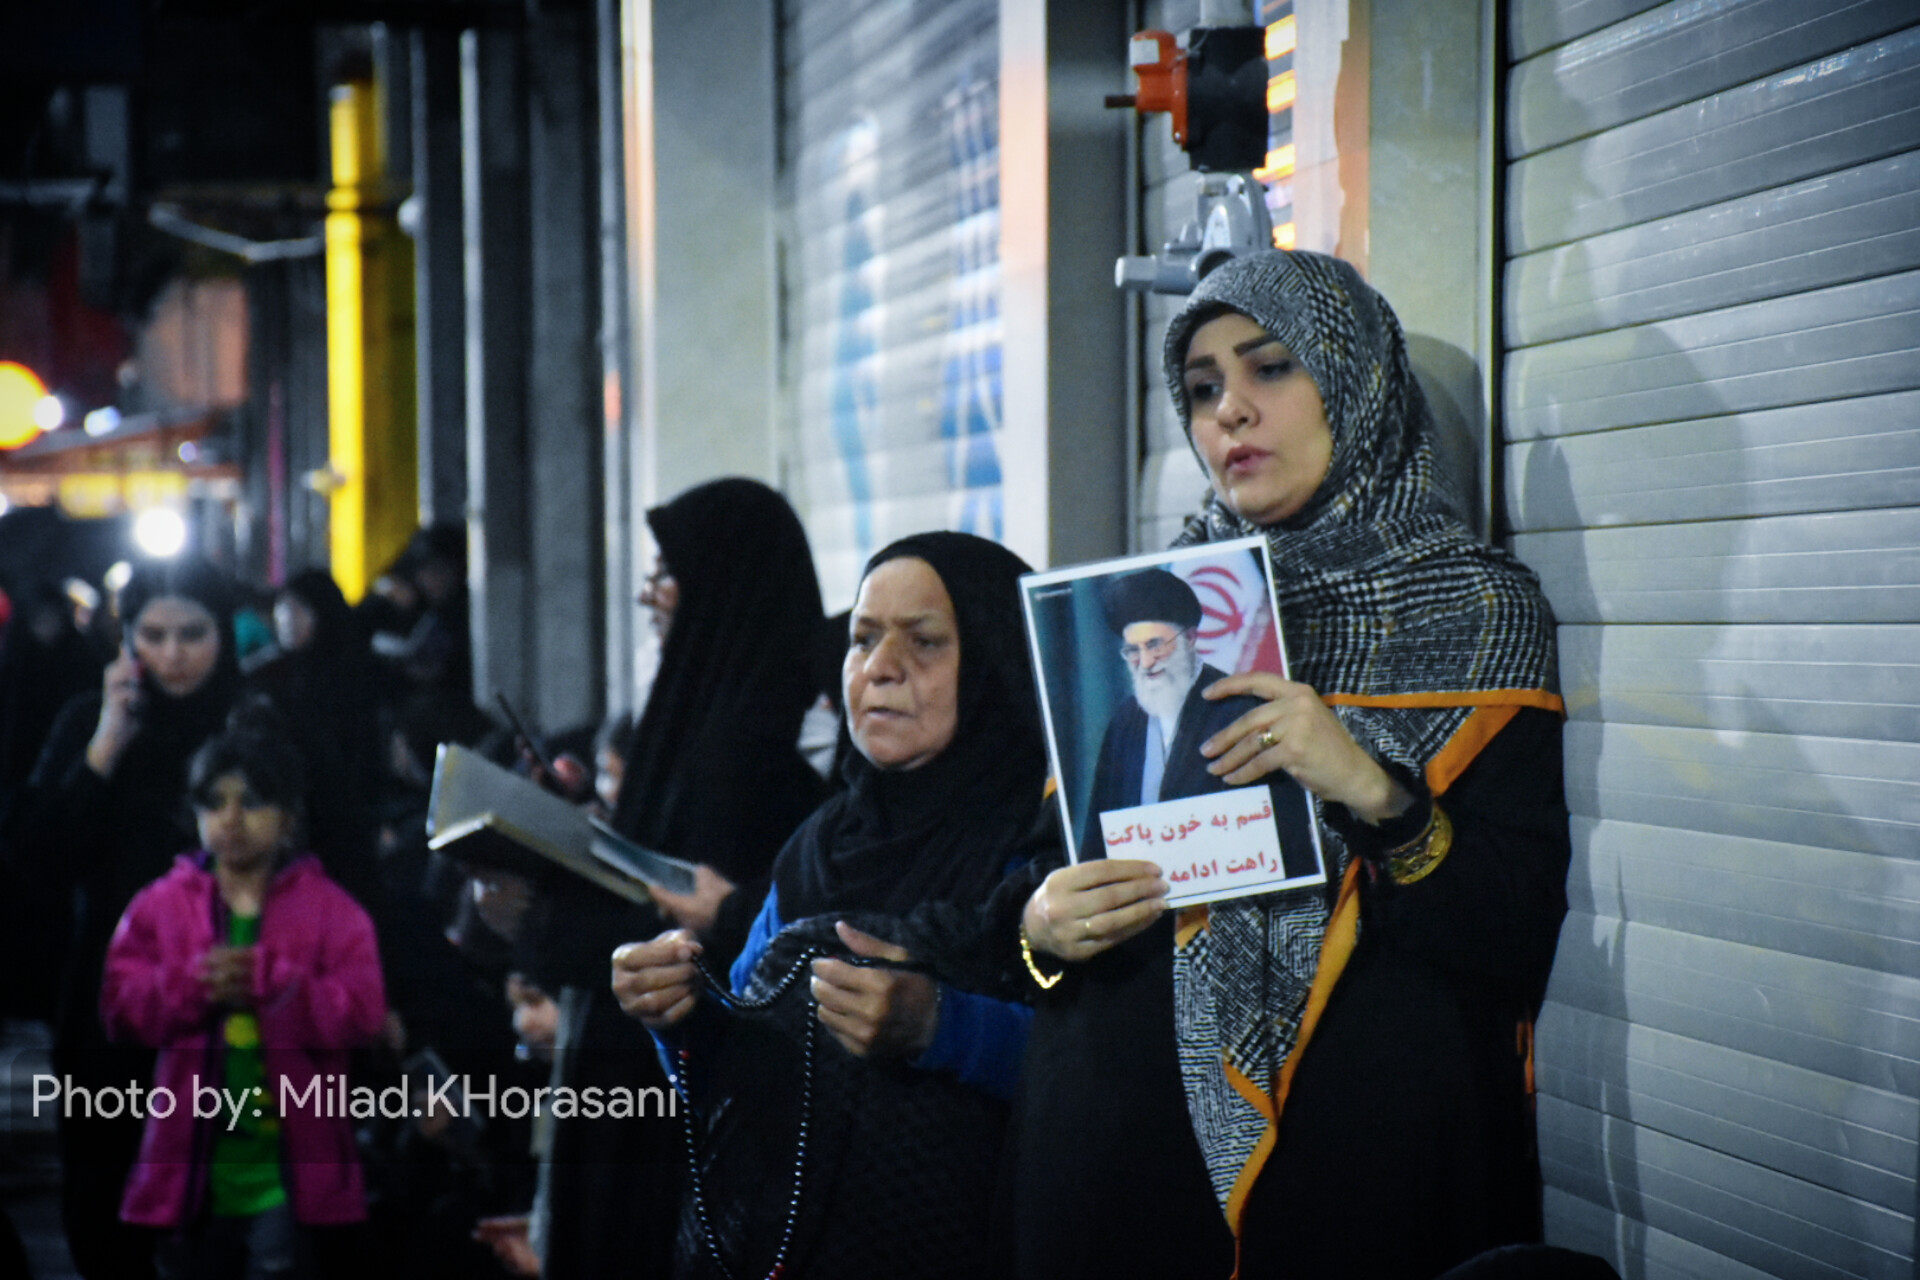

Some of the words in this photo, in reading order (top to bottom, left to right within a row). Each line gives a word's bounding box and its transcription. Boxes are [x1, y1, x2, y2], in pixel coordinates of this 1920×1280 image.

[1210, 813, 1228, 831] به
[1236, 800, 1272, 830] قسم
[1160, 813, 1202, 842] خون
[1169, 859, 1219, 882] ادامه
[1225, 851, 1278, 874] راهت
